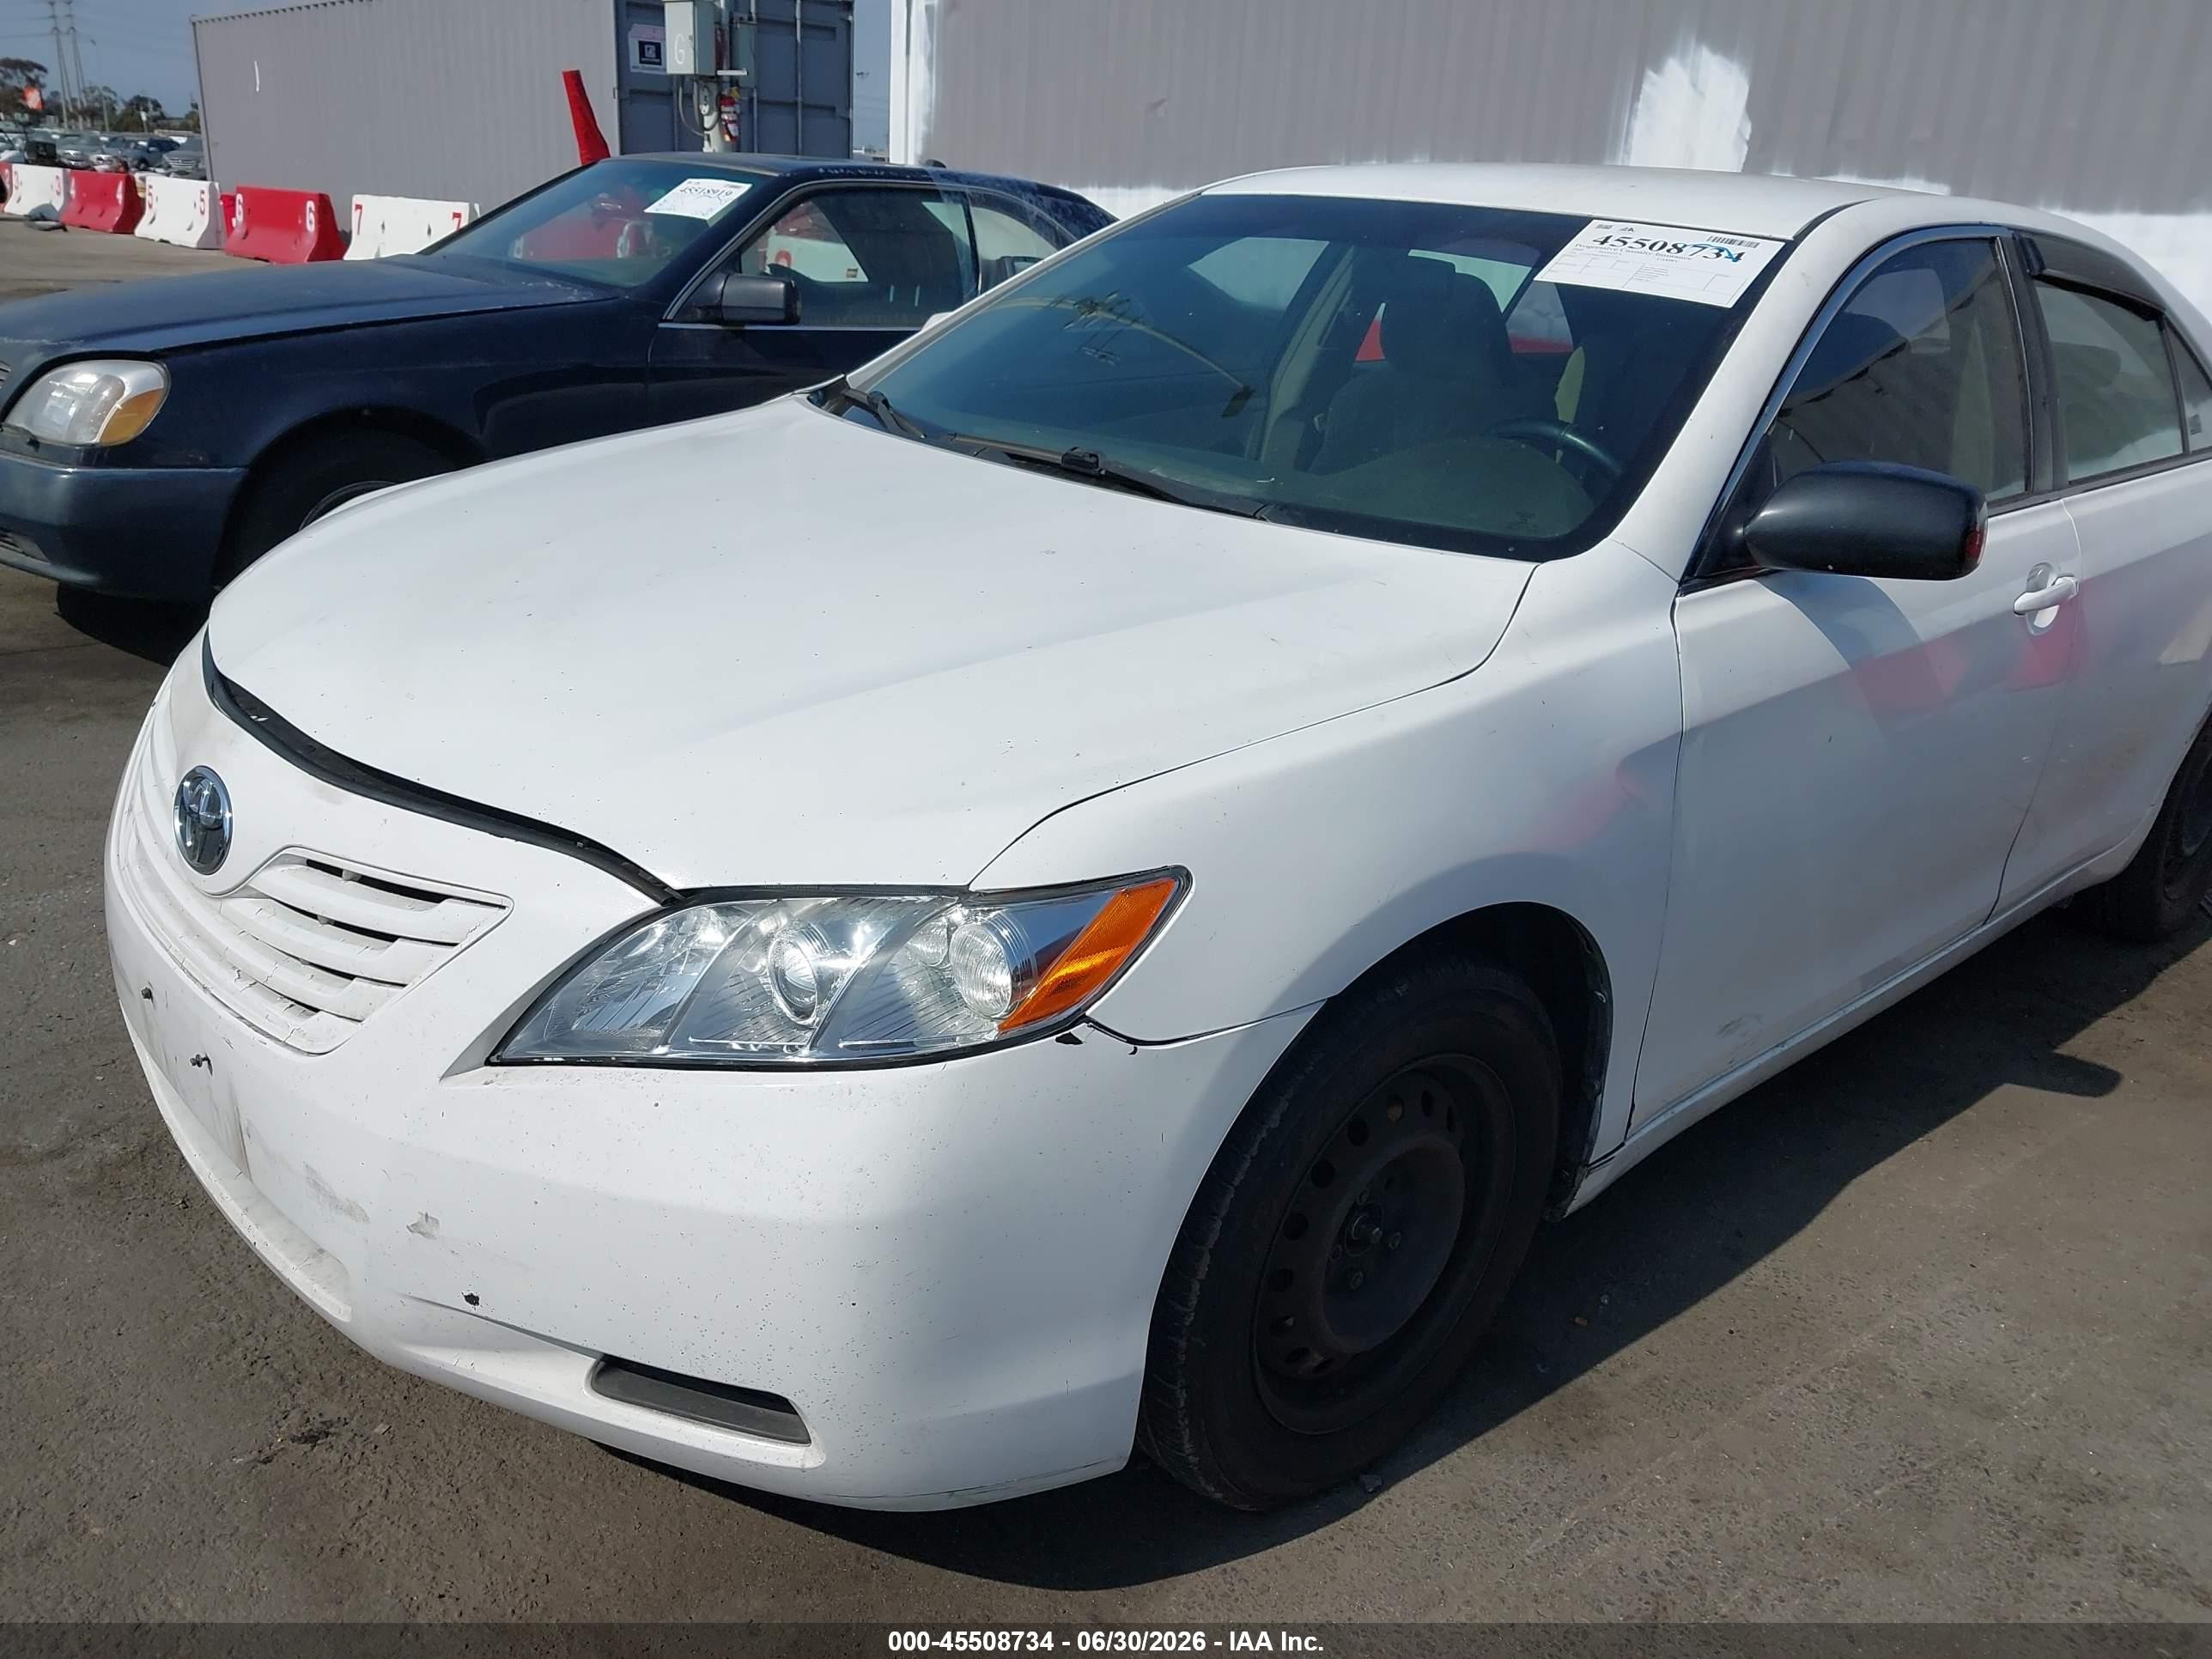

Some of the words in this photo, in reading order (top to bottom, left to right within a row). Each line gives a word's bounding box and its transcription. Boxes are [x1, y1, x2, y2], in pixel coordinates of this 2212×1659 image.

[674, 33, 685, 64] G
[55, 174, 61, 196] 3
[116, 180, 124, 205] 4
[148, 185, 154, 209] 5
[199, 190, 206, 215] 5
[235, 193, 244, 222] 6
[306, 200, 315, 233] 6
[355, 204, 362, 235] 7
[1592, 234, 1746, 262] 45508734
